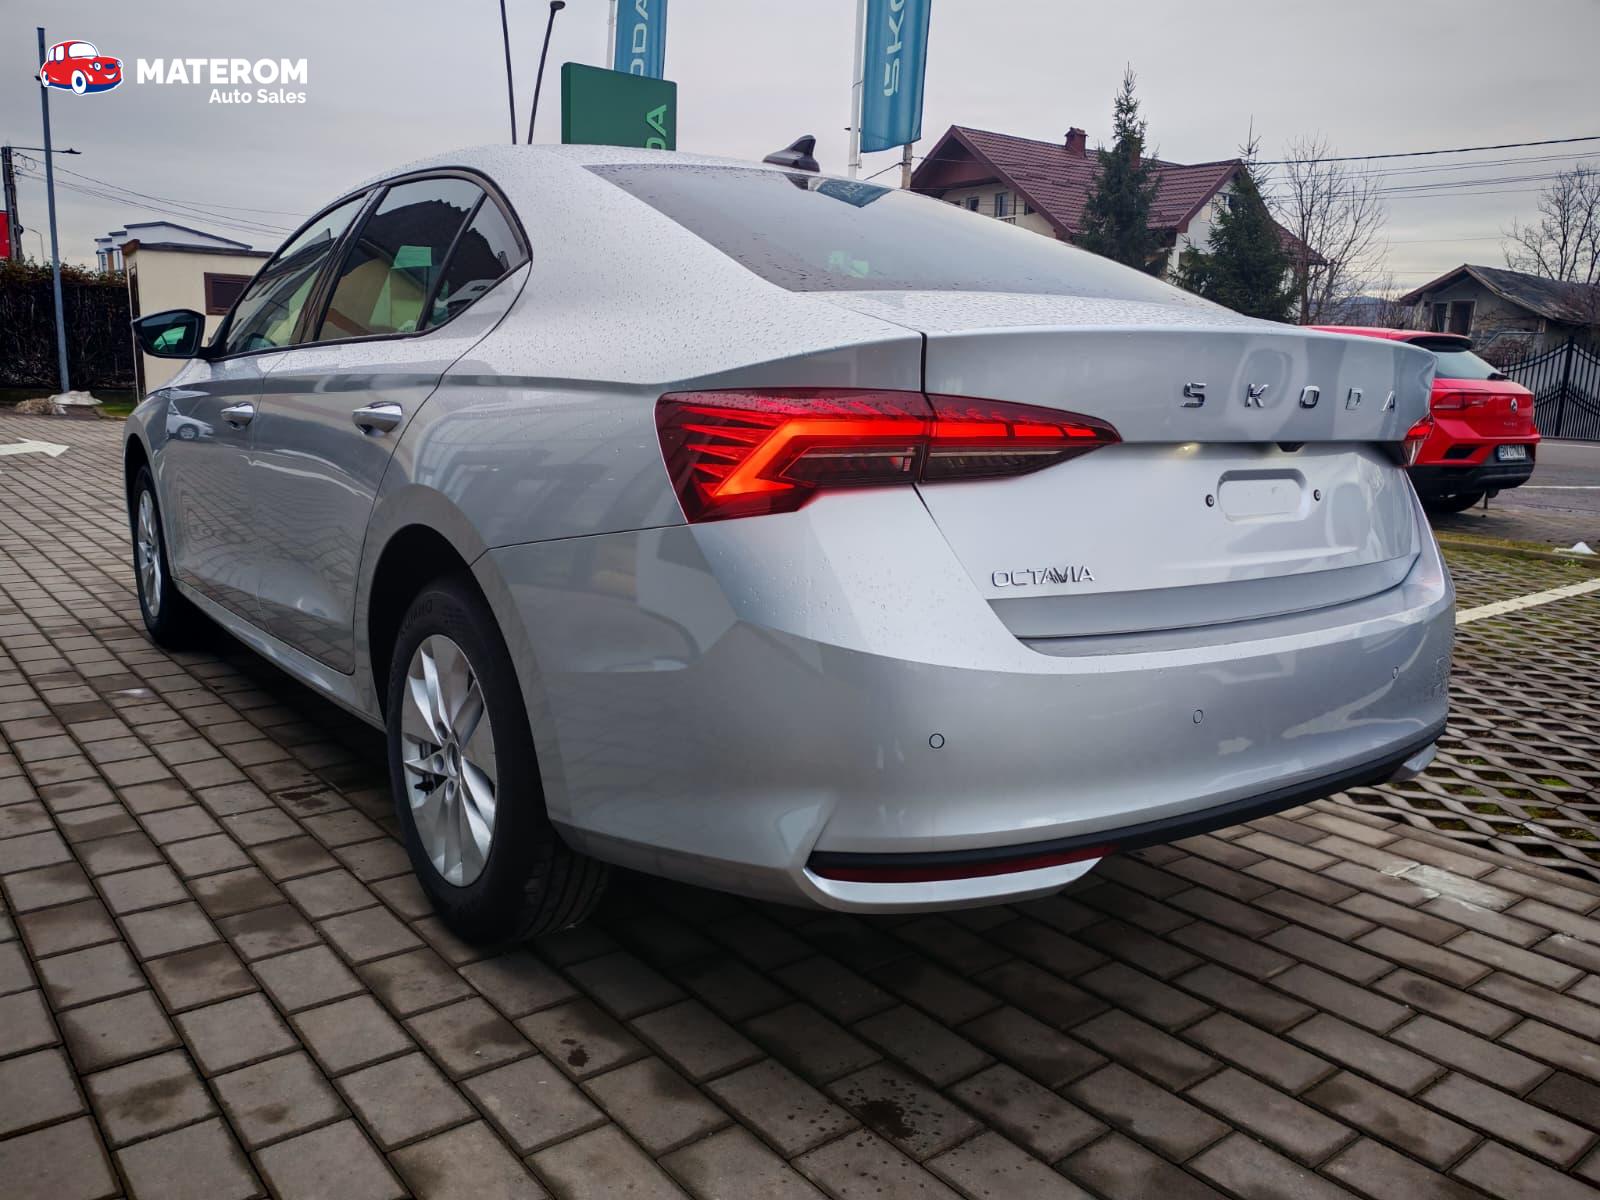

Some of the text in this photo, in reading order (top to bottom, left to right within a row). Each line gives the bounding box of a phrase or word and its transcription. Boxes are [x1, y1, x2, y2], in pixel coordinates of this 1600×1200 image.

[883, 0, 905, 97] SK
[1181, 382, 1396, 413] SKODA
[991, 565, 1095, 588] OCTAVIA
